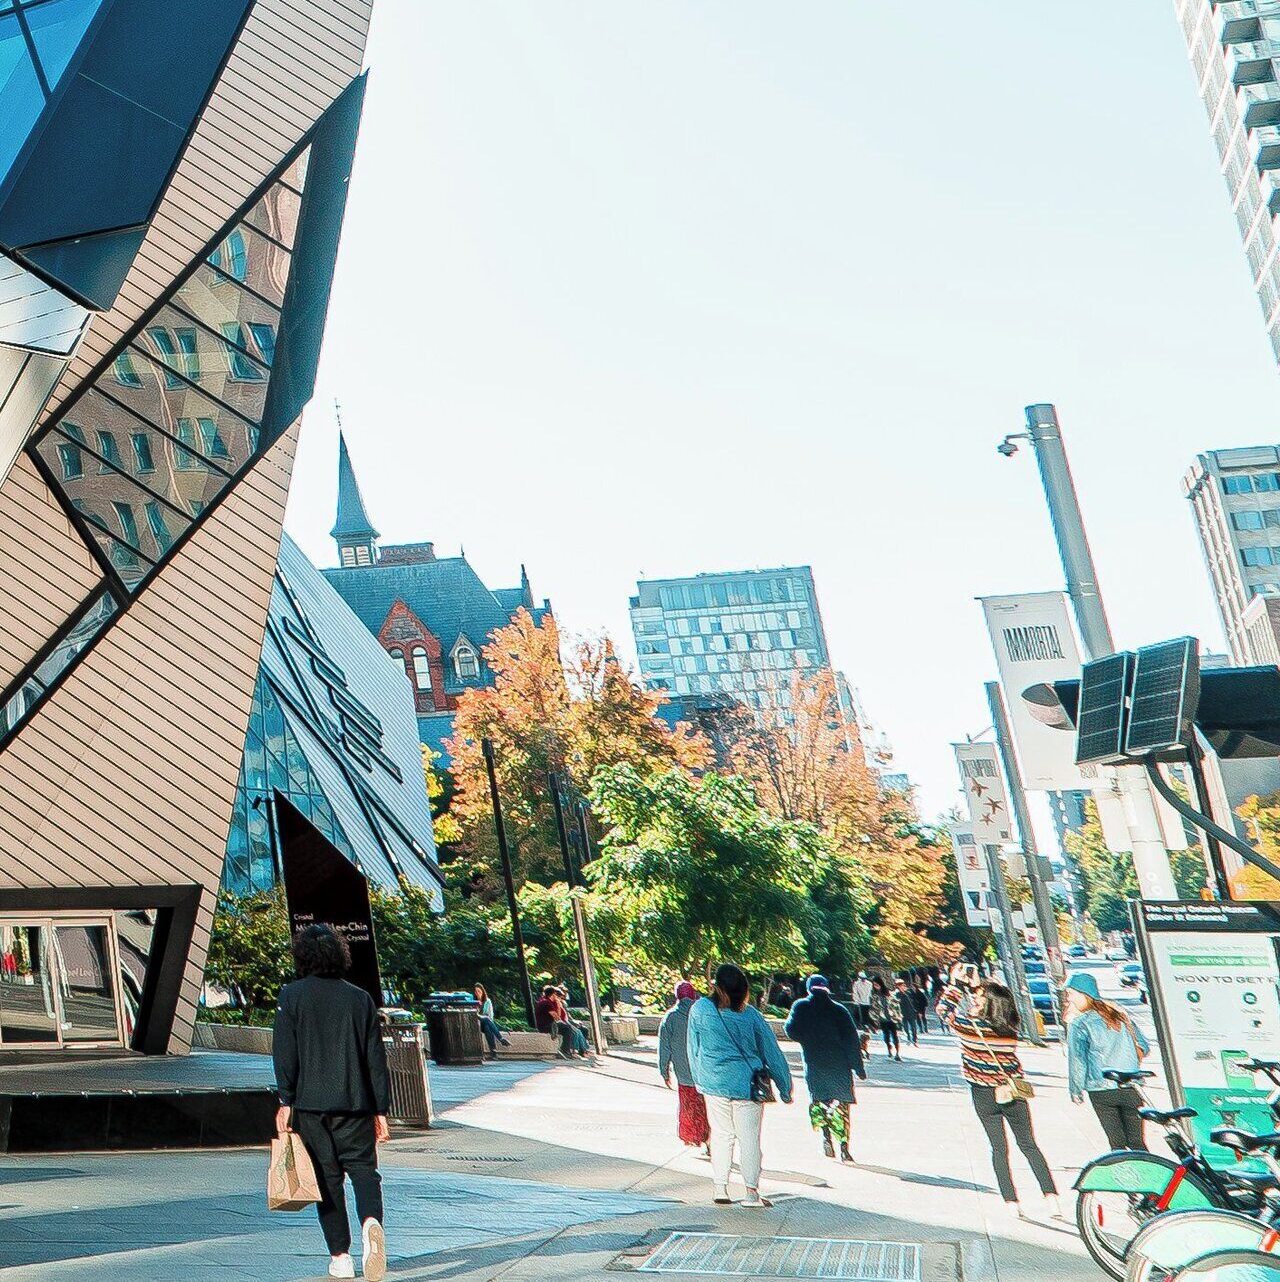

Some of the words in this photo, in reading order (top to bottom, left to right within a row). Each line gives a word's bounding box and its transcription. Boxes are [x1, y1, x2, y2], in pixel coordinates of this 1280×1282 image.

[1003, 625, 1065, 663] IMMORTAL
[1174, 975, 1210, 984] HOW
[1213, 976, 1233, 984] TO
